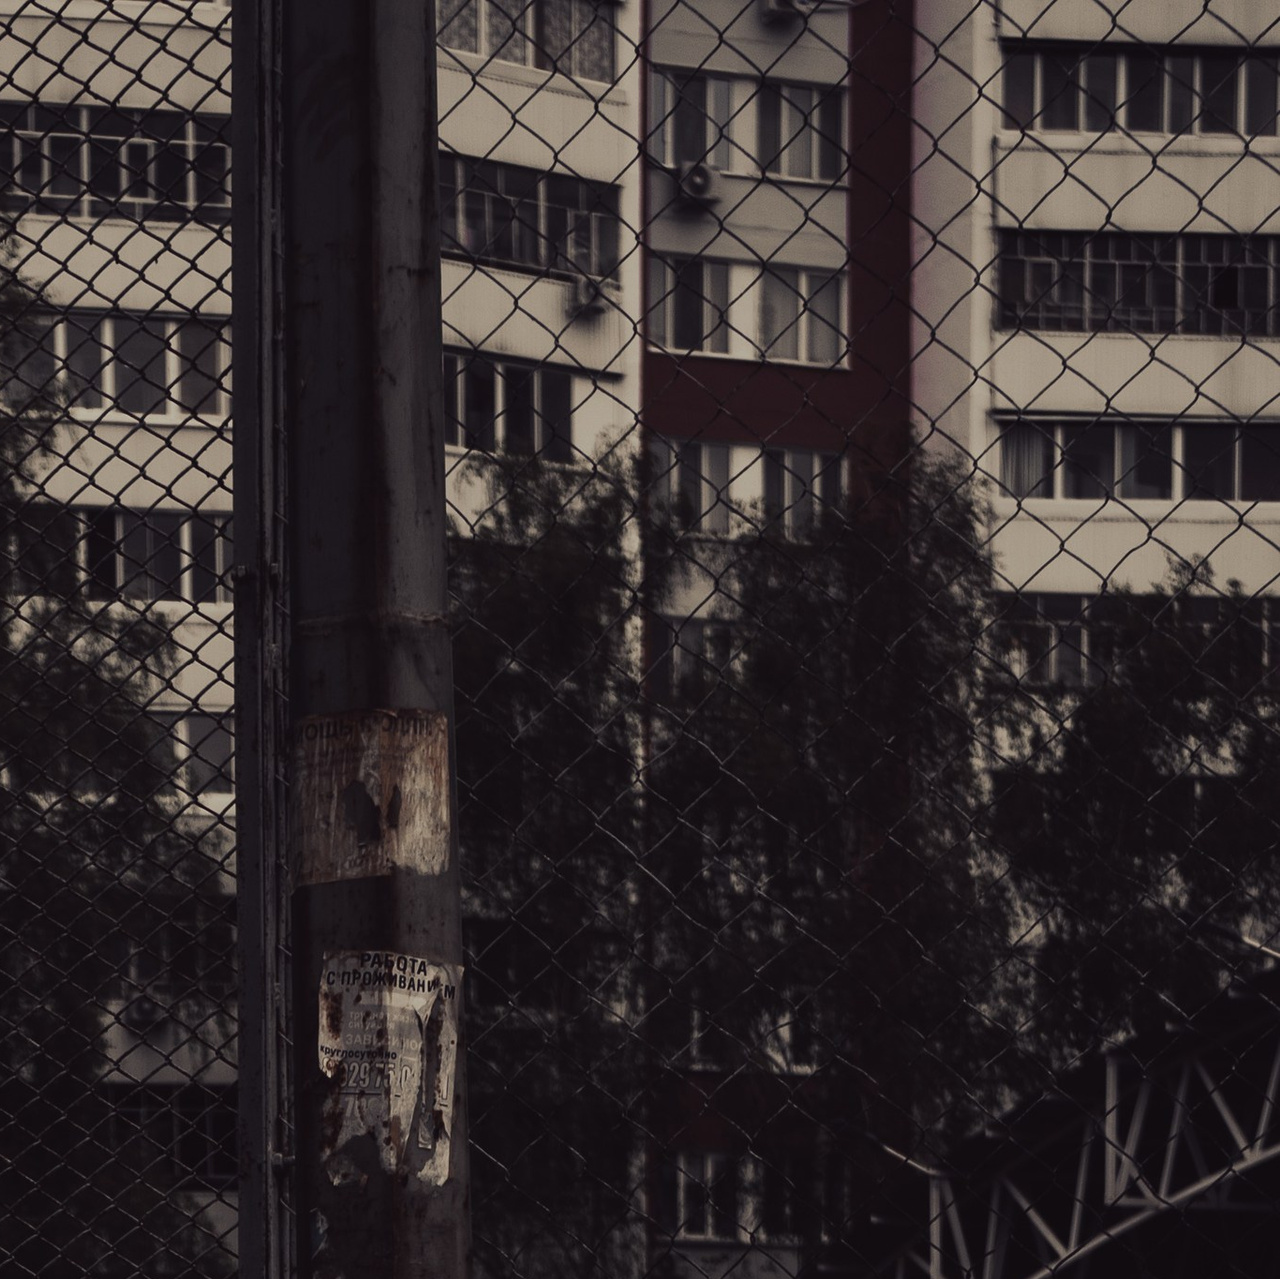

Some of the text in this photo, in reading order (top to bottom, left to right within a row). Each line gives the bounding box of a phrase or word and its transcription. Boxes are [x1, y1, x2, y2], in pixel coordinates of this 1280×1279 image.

[360, 952, 428, 977] РАБОТА
[326, 970, 457, 1001] С ПРОЖИВАНИМ
